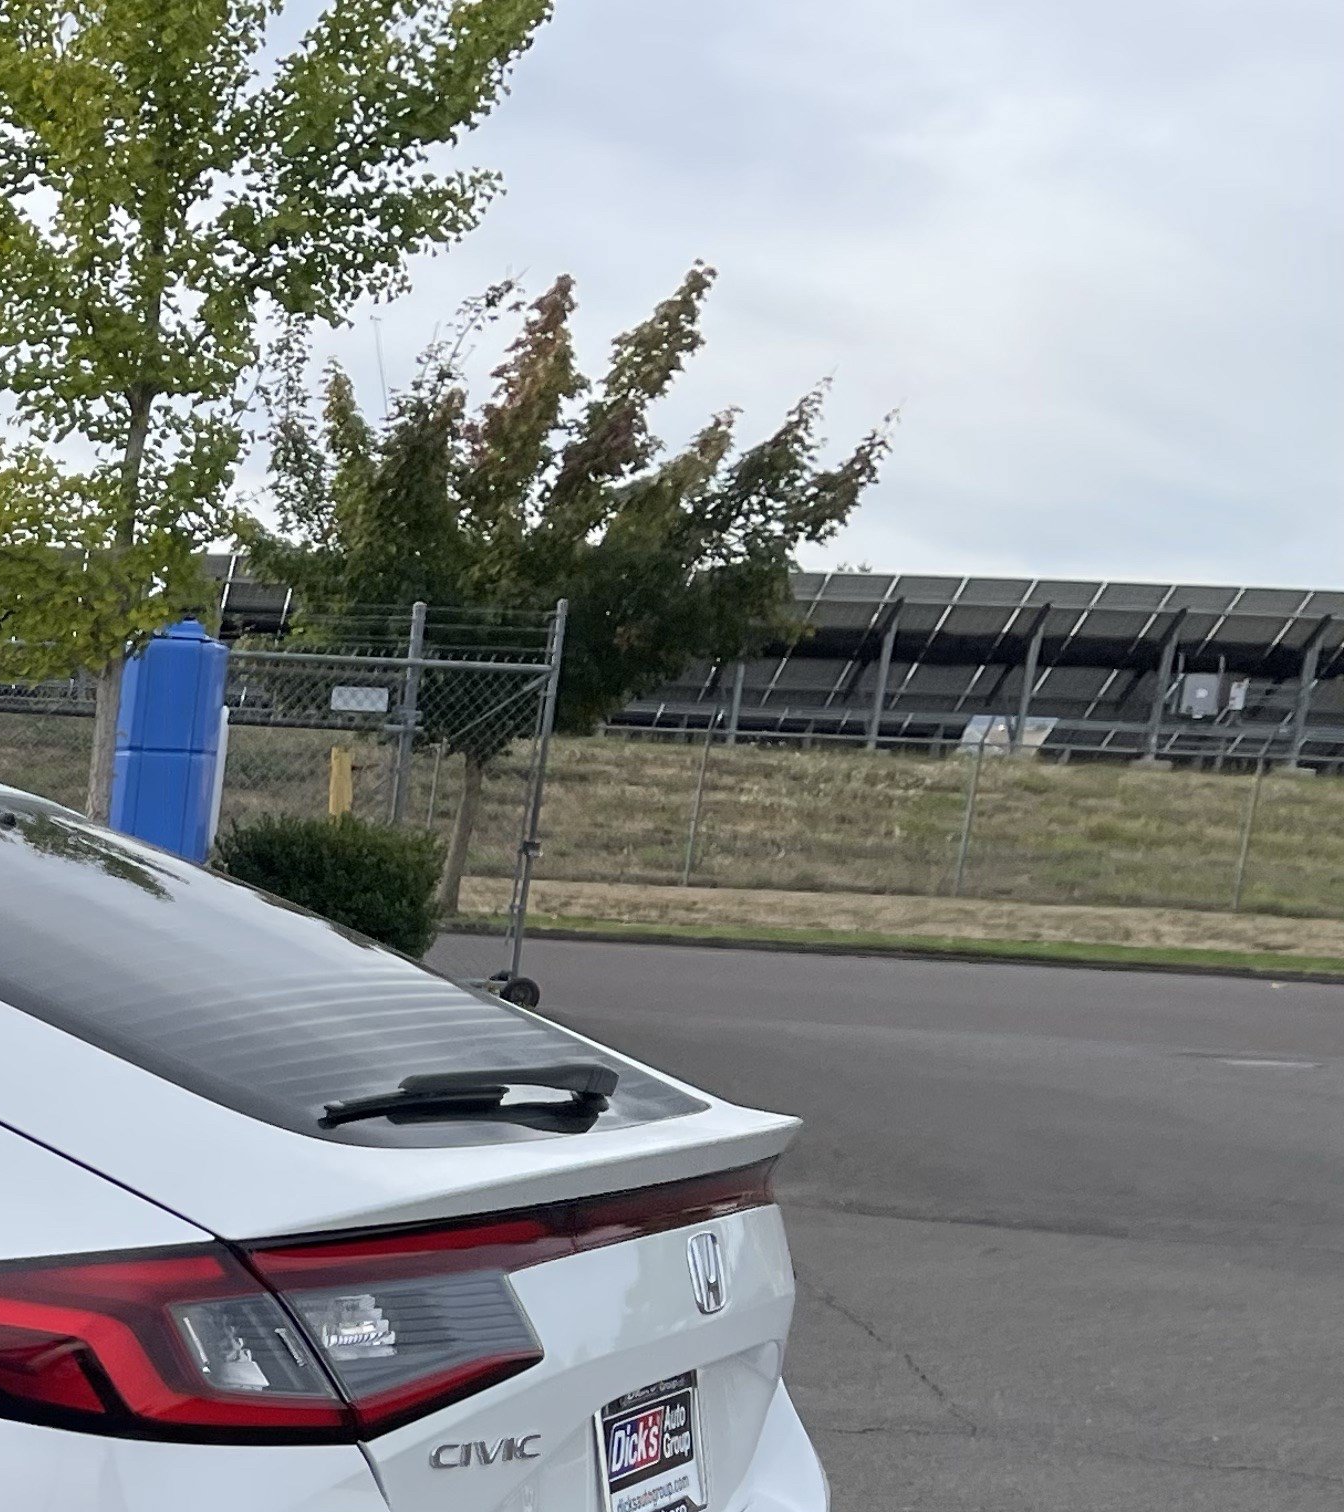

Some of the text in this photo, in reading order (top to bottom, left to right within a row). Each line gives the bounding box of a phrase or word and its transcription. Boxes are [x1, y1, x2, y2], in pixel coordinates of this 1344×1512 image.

[664, 1404, 686, 1431] Auto
[429, 1434, 541, 1468] CIVIC
[612, 1416, 659, 1472] Dick's
[663, 1431, 691, 1458] Group
